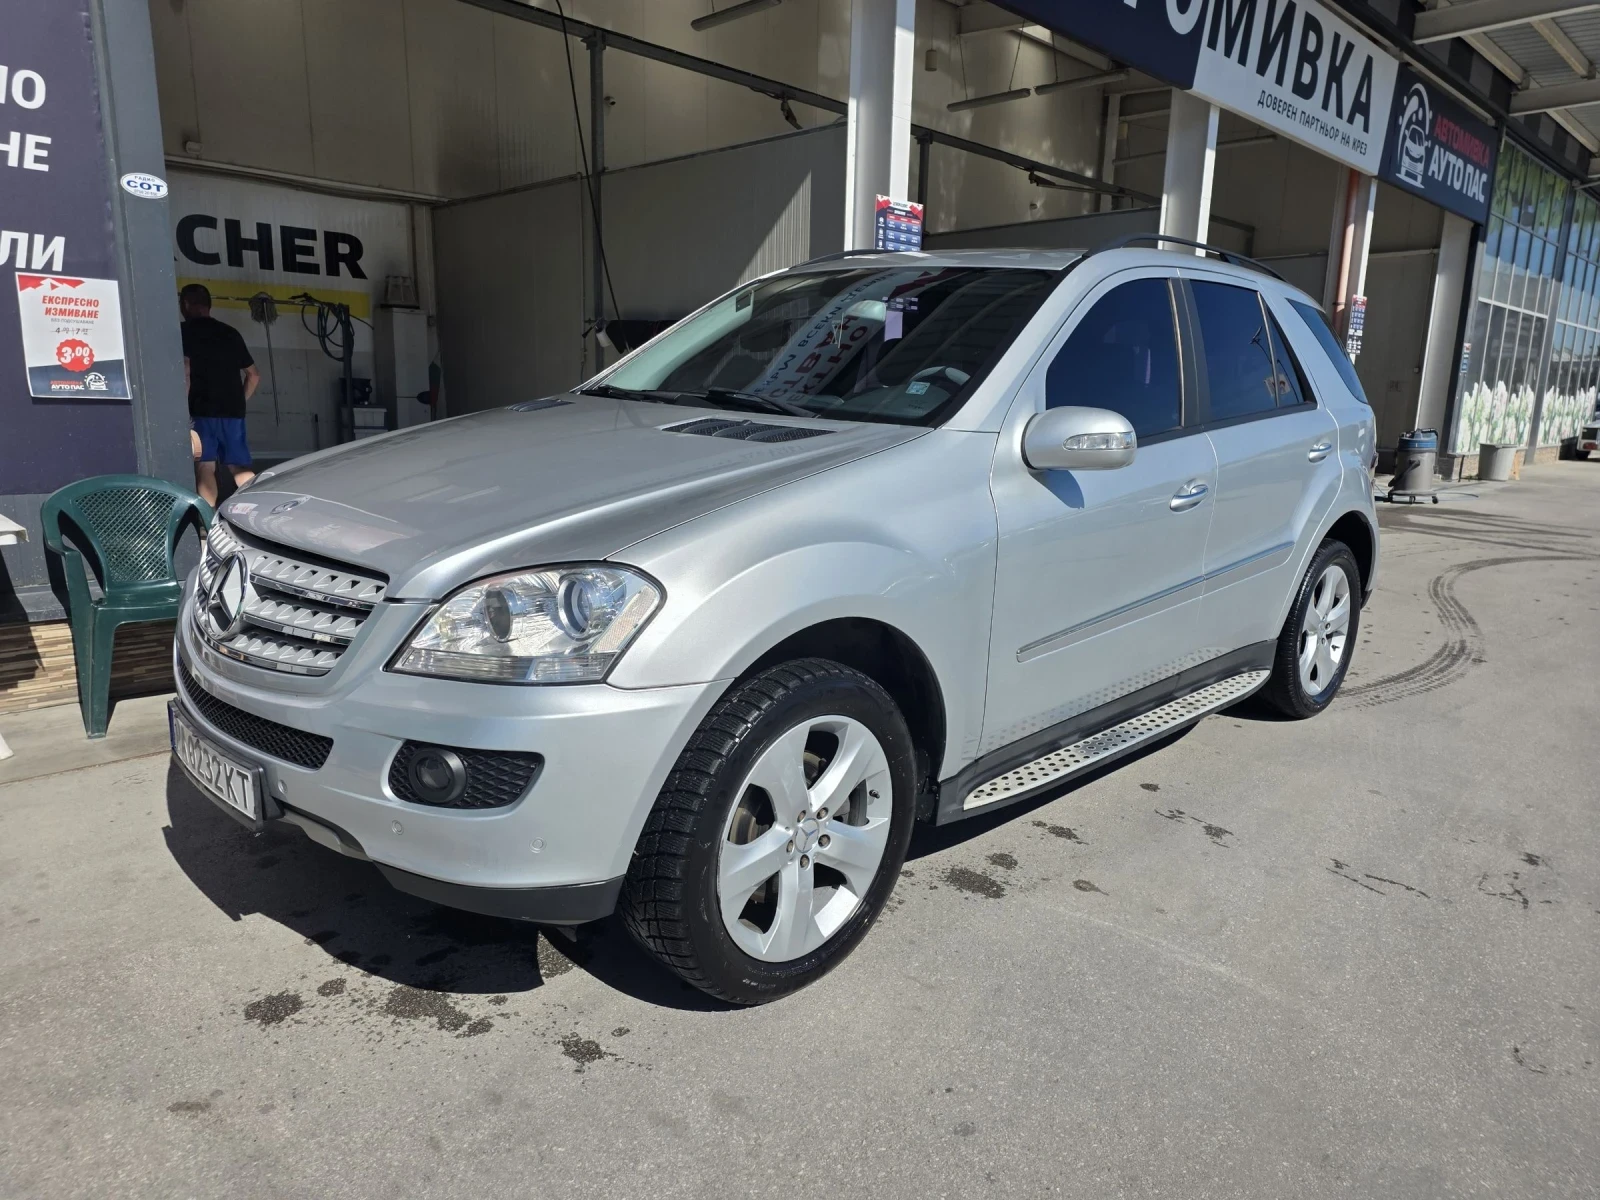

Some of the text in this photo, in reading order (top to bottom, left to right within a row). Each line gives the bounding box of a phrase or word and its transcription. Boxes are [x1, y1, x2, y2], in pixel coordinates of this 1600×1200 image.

[1257, 89, 1368, 156] ДОВЕРЕН ПАРТНЬОР НА КРЕЗ
[1433, 114, 1489, 169] АВТОМИВКА
[126, 179, 164, 192] СОТ
[134, 175, 156, 183] РАДИО
[1427, 144, 1488, 203] АУТО ПАС
[174, 214, 368, 280] CHER
[42, 295, 99, 308] ЕКСПРЕСНО
[44, 307, 99, 319] ИЗМИВАНЕ
